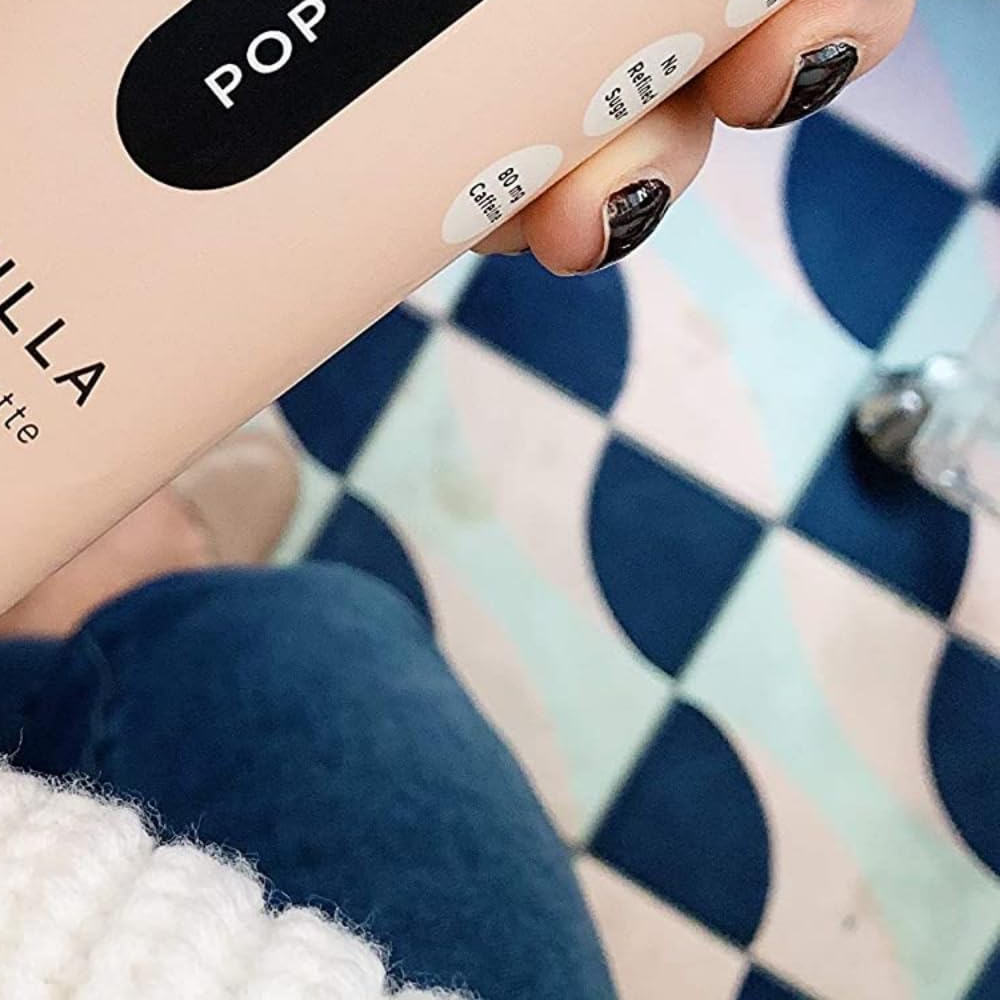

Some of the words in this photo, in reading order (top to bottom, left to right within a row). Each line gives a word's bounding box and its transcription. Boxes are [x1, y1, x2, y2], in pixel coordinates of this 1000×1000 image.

[660, 54, 678, 76] No
[627, 61, 659, 105] Refined
[605, 87, 629, 121] Sugar
[498, 167, 519, 187] 80
[469, 182, 502, 224] Caffeine
[507, 185, 526, 204] mg
